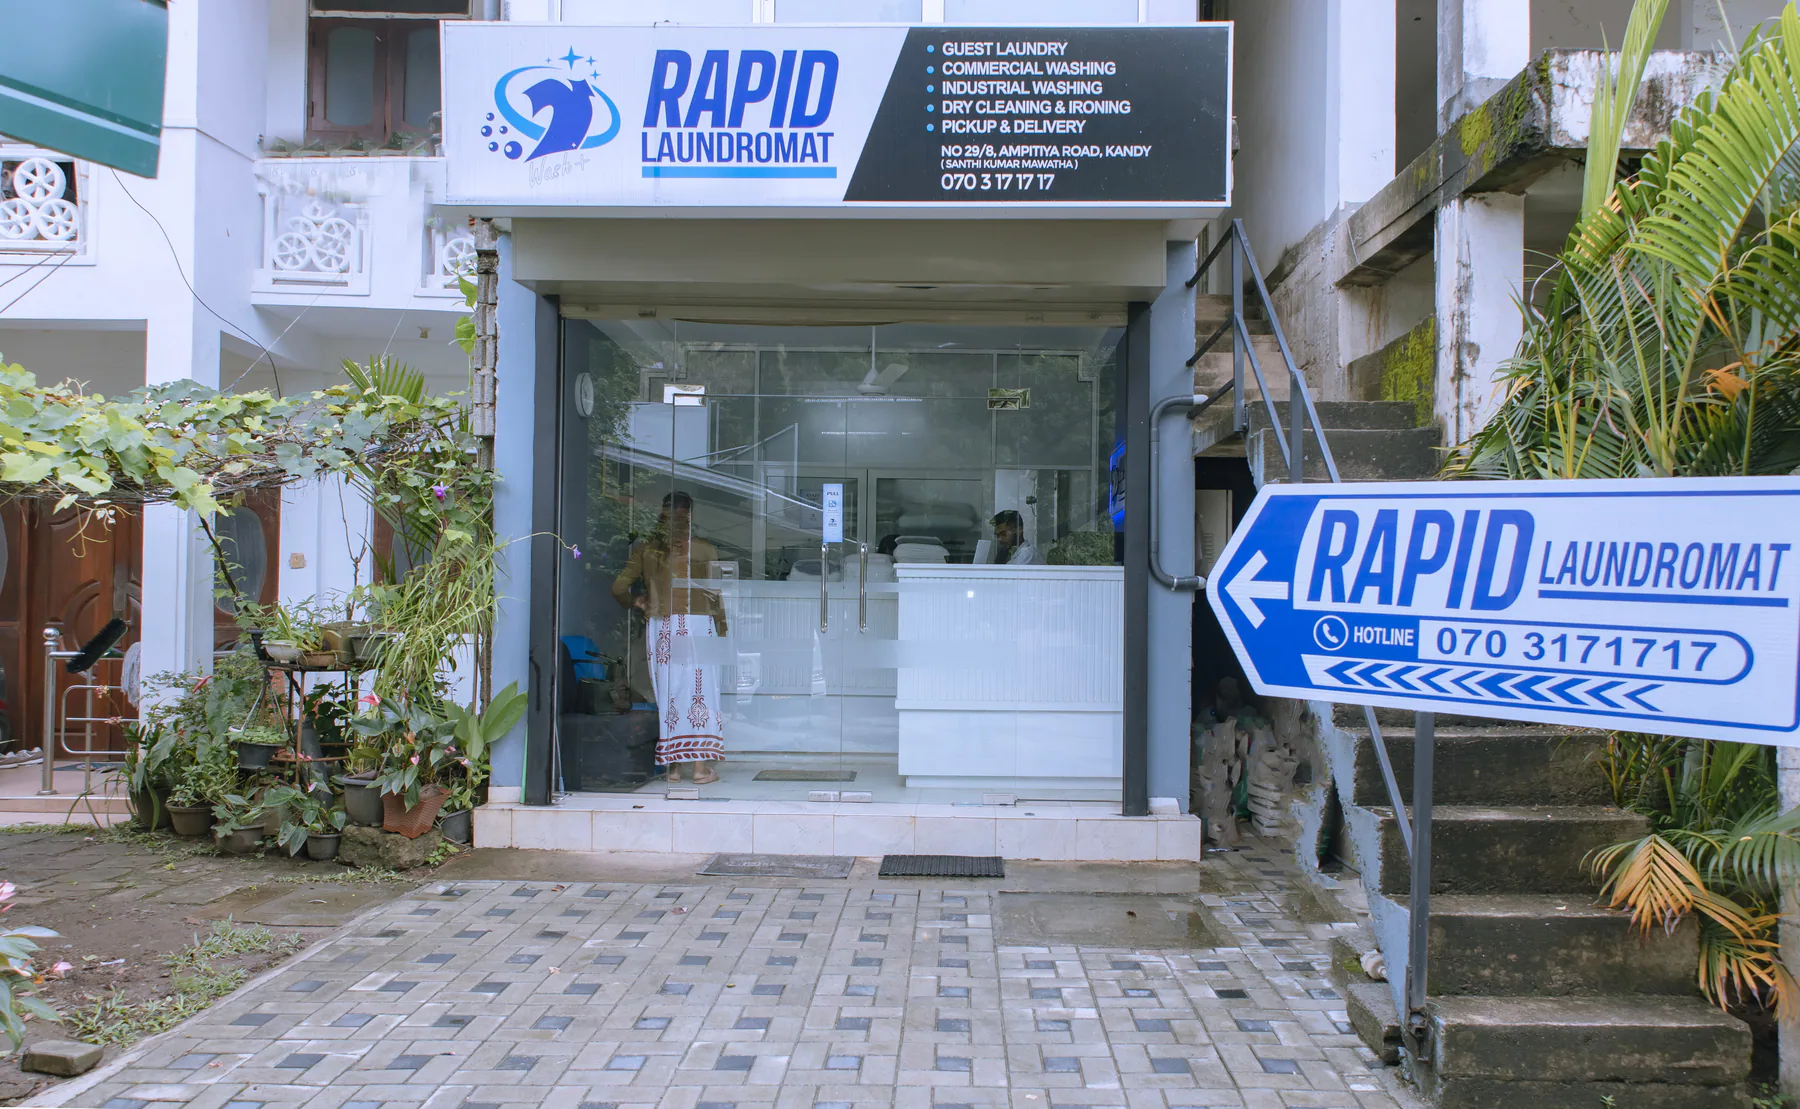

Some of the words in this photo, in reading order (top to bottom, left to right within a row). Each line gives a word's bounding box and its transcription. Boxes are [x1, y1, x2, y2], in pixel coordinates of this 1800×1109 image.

[942, 42, 994, 56] GUEST
[996, 42, 1068, 56] LAUNDRY
[942, 61, 1044, 76] COMMERCIAL
[1045, 61, 1117, 76] WASHING
[642, 49, 839, 128] RAPID
[942, 80, 1031, 95] INDUSTRIAL
[1032, 80, 1103, 95] WASHING
[942, 100, 974, 115] DRY
[975, 100, 1052, 115] CLEANING
[1054, 100, 1067, 115] &
[1068, 100, 1131, 115] IRONING
[942, 119, 998, 134] PICKUP
[999, 119, 1012, 134] &
[1013, 119, 1087, 134] DELIVERY
[641, 131, 835, 163] LAUNDROMAT
[941, 144, 963, 158] NO
[964, 143, 998, 159] 29/8,
[998, 144, 1061, 158] AMPITIYA
[1062, 144, 1104, 159] ROAD,
[1105, 145, 1152, 158] KANDY
[983, 159, 1021, 169] KUMAR
[941, 173, 977, 191] 070
[1307, 509, 1535, 611] RAPID
[1539, 541, 1791, 591] LAUNDROMAT
[1353, 626, 1414, 647] HOTLINE
[1436, 627, 1508, 659] 070
[1522, 631, 1718, 672] 3171717
